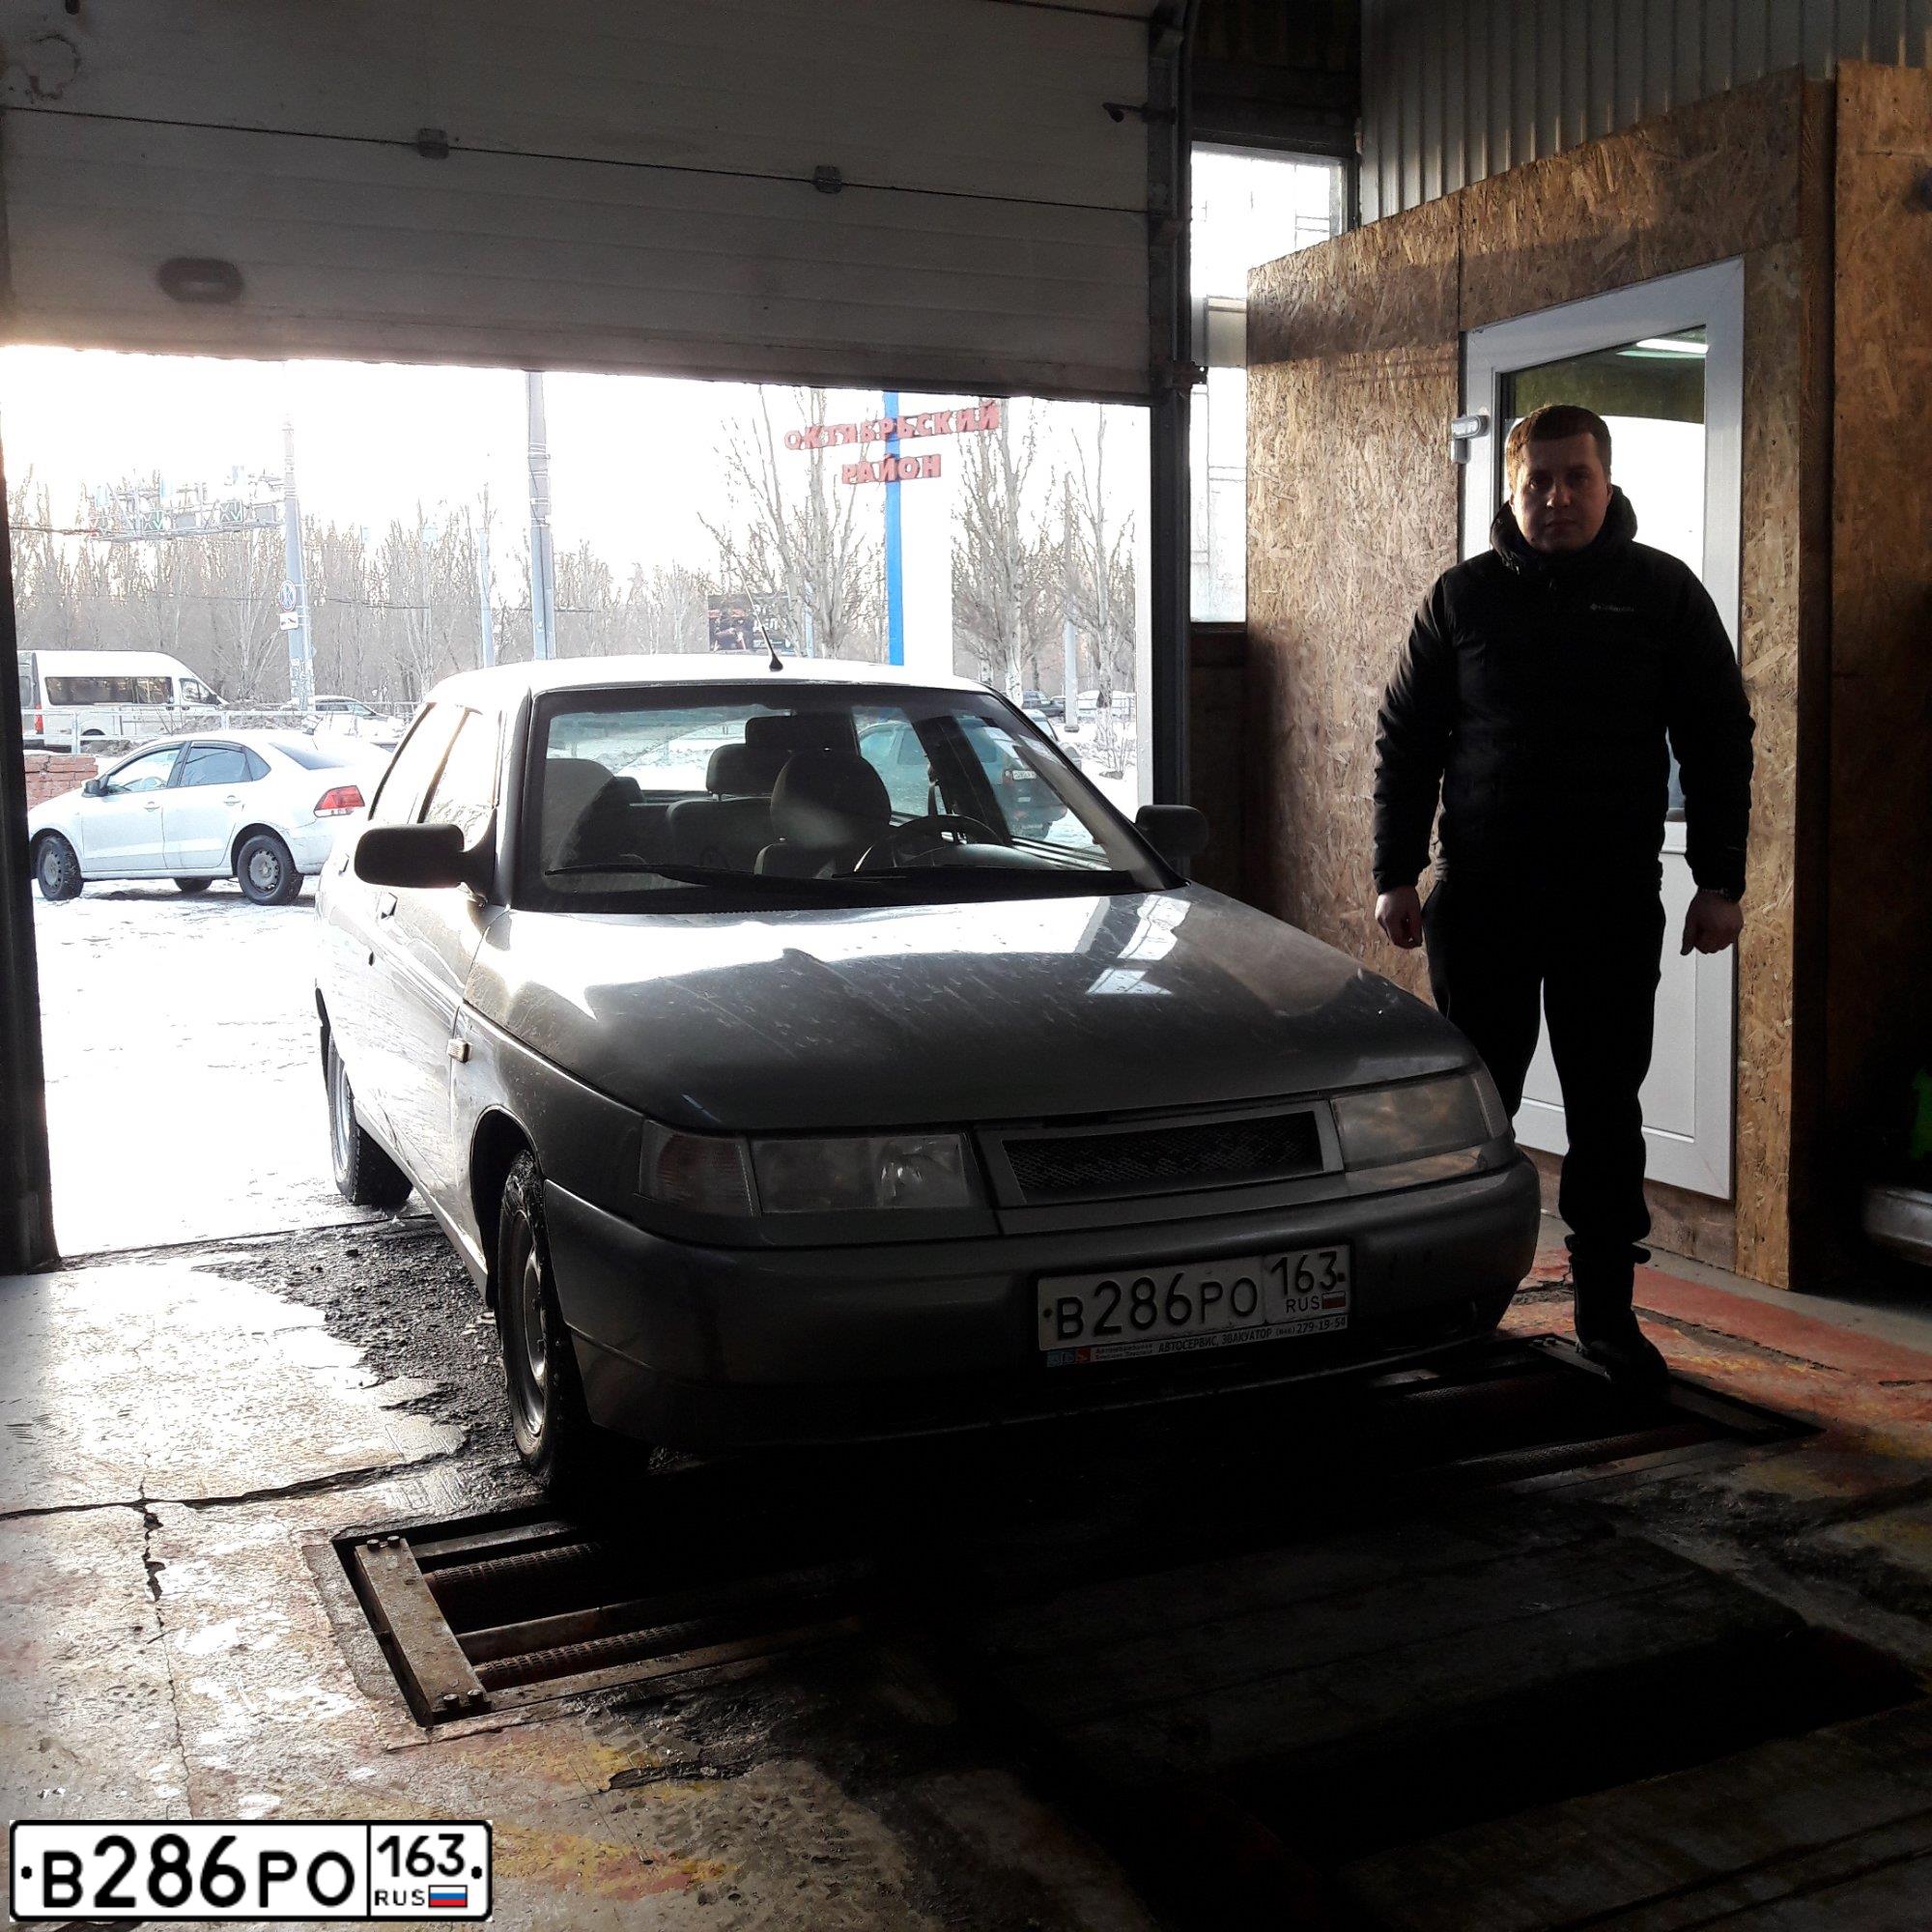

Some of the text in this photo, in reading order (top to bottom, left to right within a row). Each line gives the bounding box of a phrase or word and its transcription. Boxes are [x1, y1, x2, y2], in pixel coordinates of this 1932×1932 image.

[784, 399, 1000, 450] ОКТЯБРЬСКИЙ
[841, 453, 942, 484] РАЙОН
[1057, 1251, 1338, 1341] В286РО 163
[1286, 1295, 1321, 1314] RUS
[1222, 1328, 1272, 1346] ЭВАКУАТОР
